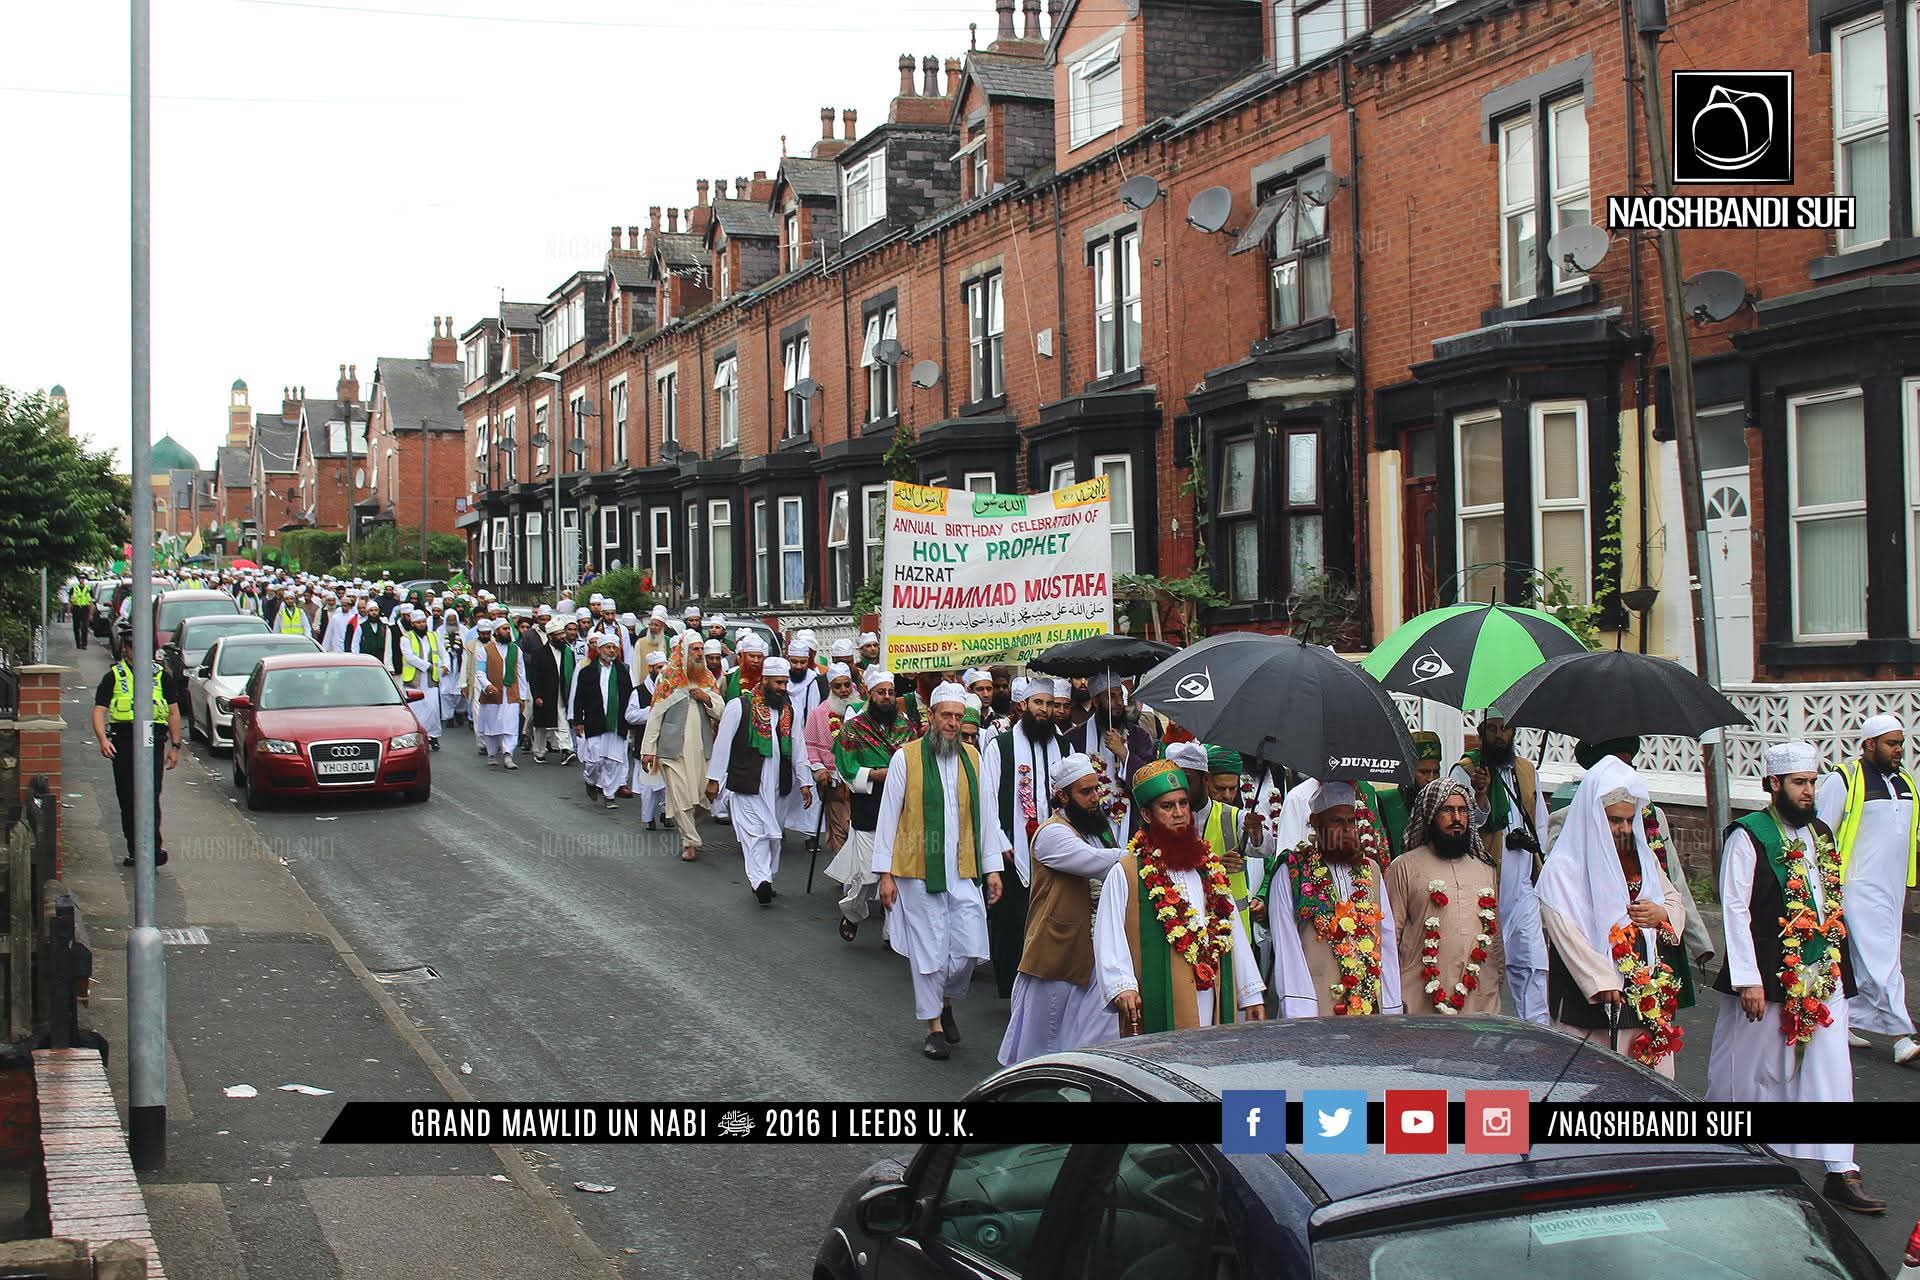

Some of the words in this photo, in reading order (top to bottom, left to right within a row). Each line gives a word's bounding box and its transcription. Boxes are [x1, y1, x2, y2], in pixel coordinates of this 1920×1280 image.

[893, 518, 937, 536] ANNUAL
[945, 523, 1003, 538] BIRTHDAY
[1085, 509, 1099, 523] OF
[913, 541, 969, 562] HOLY
[986, 533, 1071, 561] PROPHET
[895, 565, 954, 582] HAZRAT
[893, 582, 1017, 609] MUHAMMAD
[1024, 573, 1107, 602] MUSTAFA
[888, 642, 938, 653] ORGANISED
[941, 642, 958, 651] BY:
[962, 632, 1042, 651] NAQSHBANDIYA
[1046, 628, 1101, 642] ASLAMIYA
[895, 656, 953, 670] SPIRITUAL
[961, 653, 1007, 666] CENTRE
[1017, 648, 1046, 661] BOLT
[1340, 757, 1402, 769] DUNLOP
